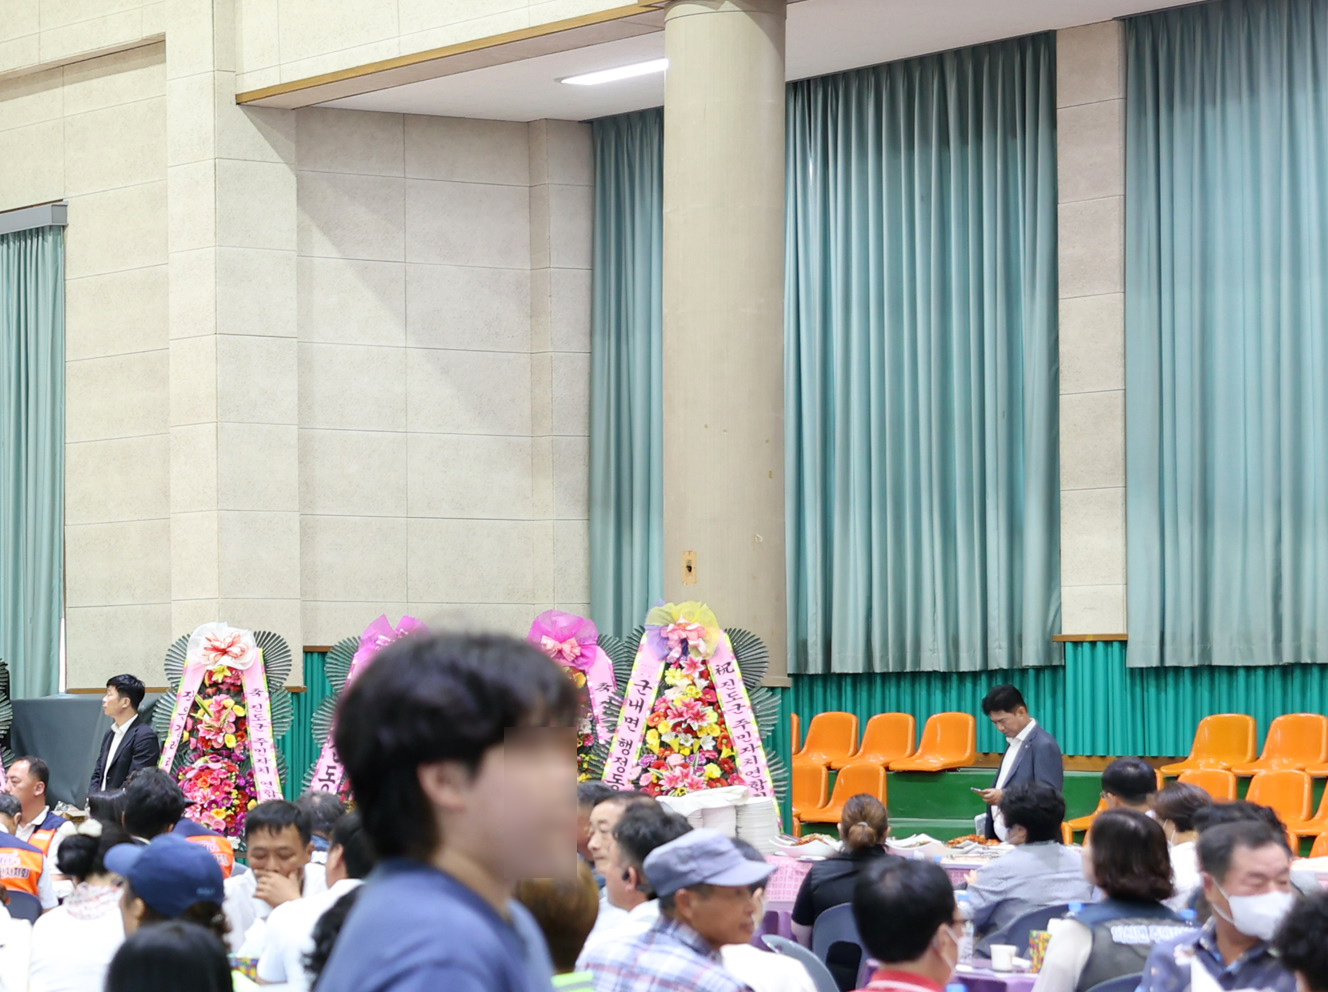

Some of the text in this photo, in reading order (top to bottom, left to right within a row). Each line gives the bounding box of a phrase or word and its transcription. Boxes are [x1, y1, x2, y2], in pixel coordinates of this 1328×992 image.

[715, 661, 735, 676] 祝
[624, 679, 652, 733] 군내면
[721, 678, 746, 715] 진도군
